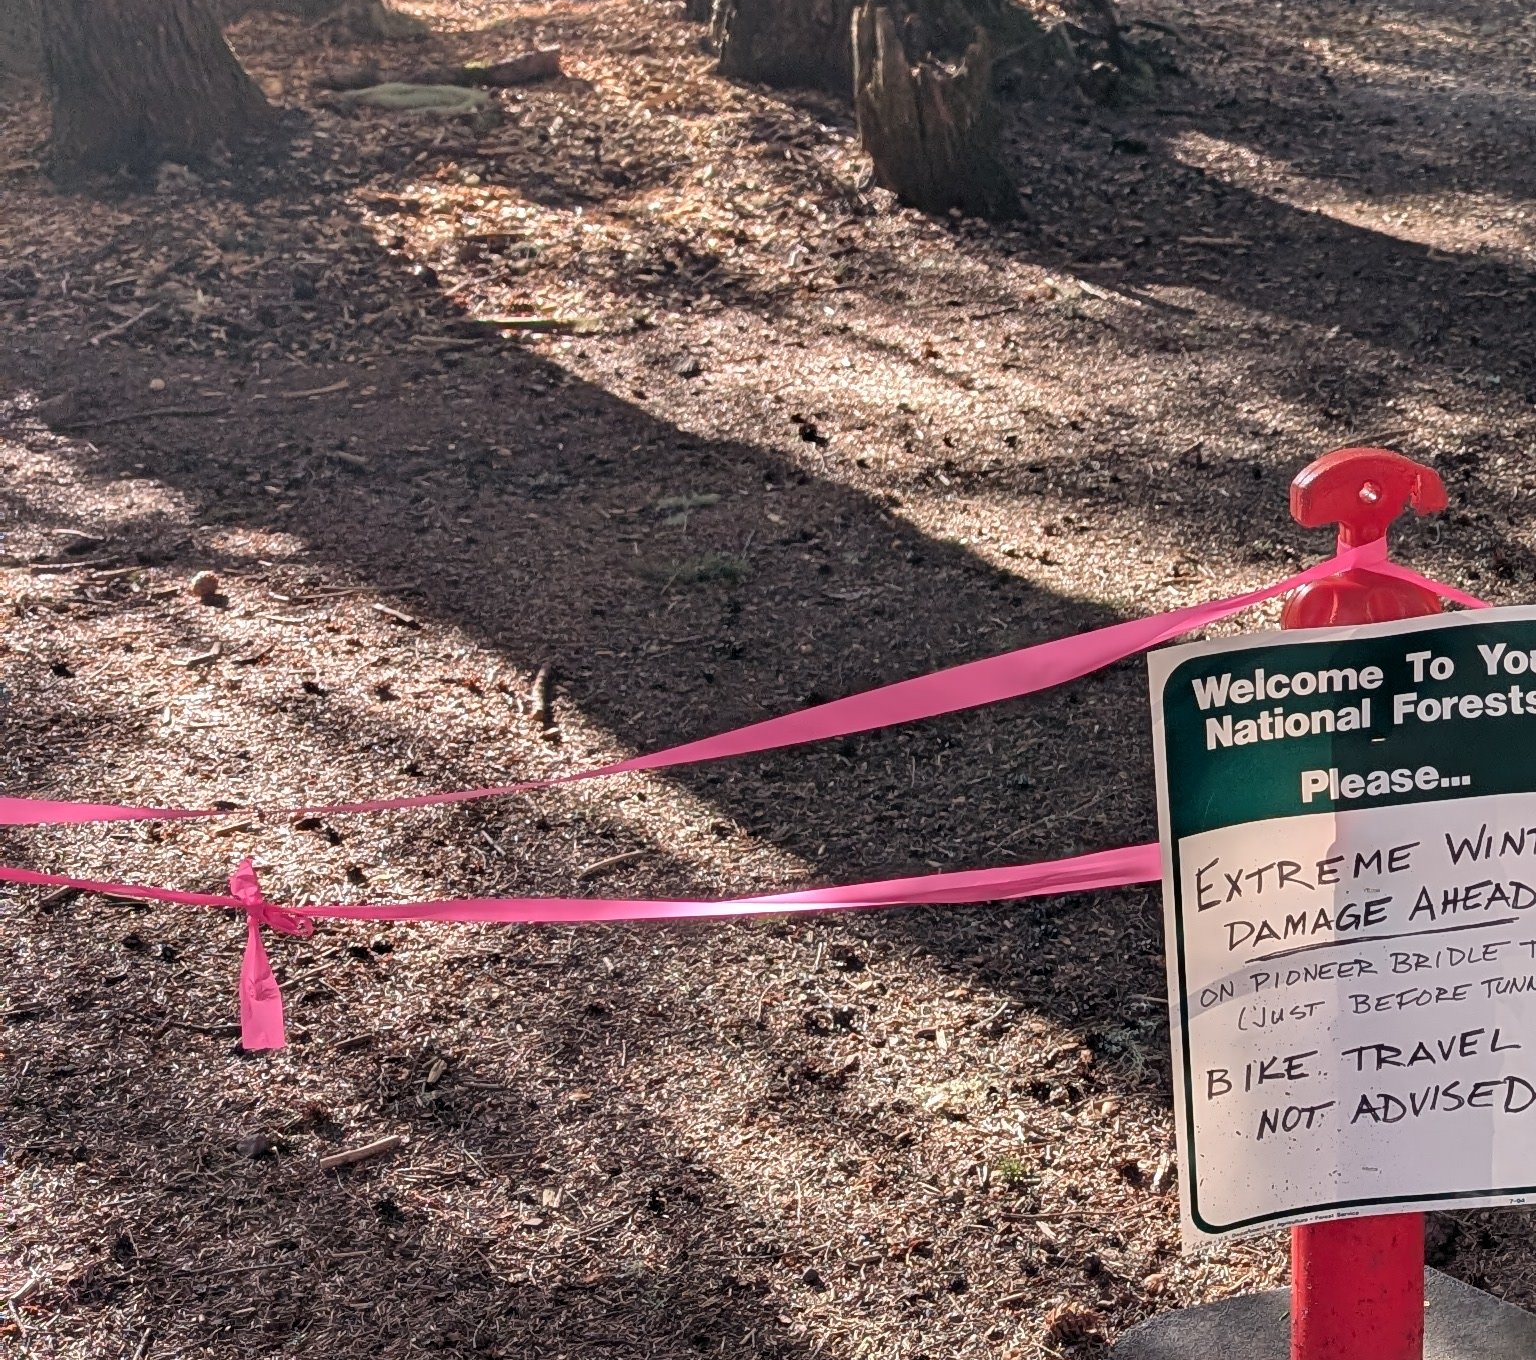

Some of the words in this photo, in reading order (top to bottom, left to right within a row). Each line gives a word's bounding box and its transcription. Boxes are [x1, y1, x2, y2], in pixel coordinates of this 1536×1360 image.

[1191, 663, 1384, 710] Welcome
[1405, 650, 1455, 682] To
[1205, 697, 1371, 750] National
[1301, 764, 1471, 803] Please...
[1195, 841, 1420, 912] EXTREME
[1224, 895, 1393, 952] DAMAGE
[1200, 981, 1235, 1008] ON
[1249, 959, 1378, 991] PIONEER
[1390, 940, 1512, 974] BRIDLE
[1238, 1000, 1326, 1031] (JUST
[1349, 982, 1473, 1015] BEFORE
[1206, 1050, 1319, 1100] BIKE
[1341, 1027, 1522, 1072] TRAVEL
[1256, 1100, 1336, 1140] NOT
[1350, 1075, 1536, 1125] ADVISED
